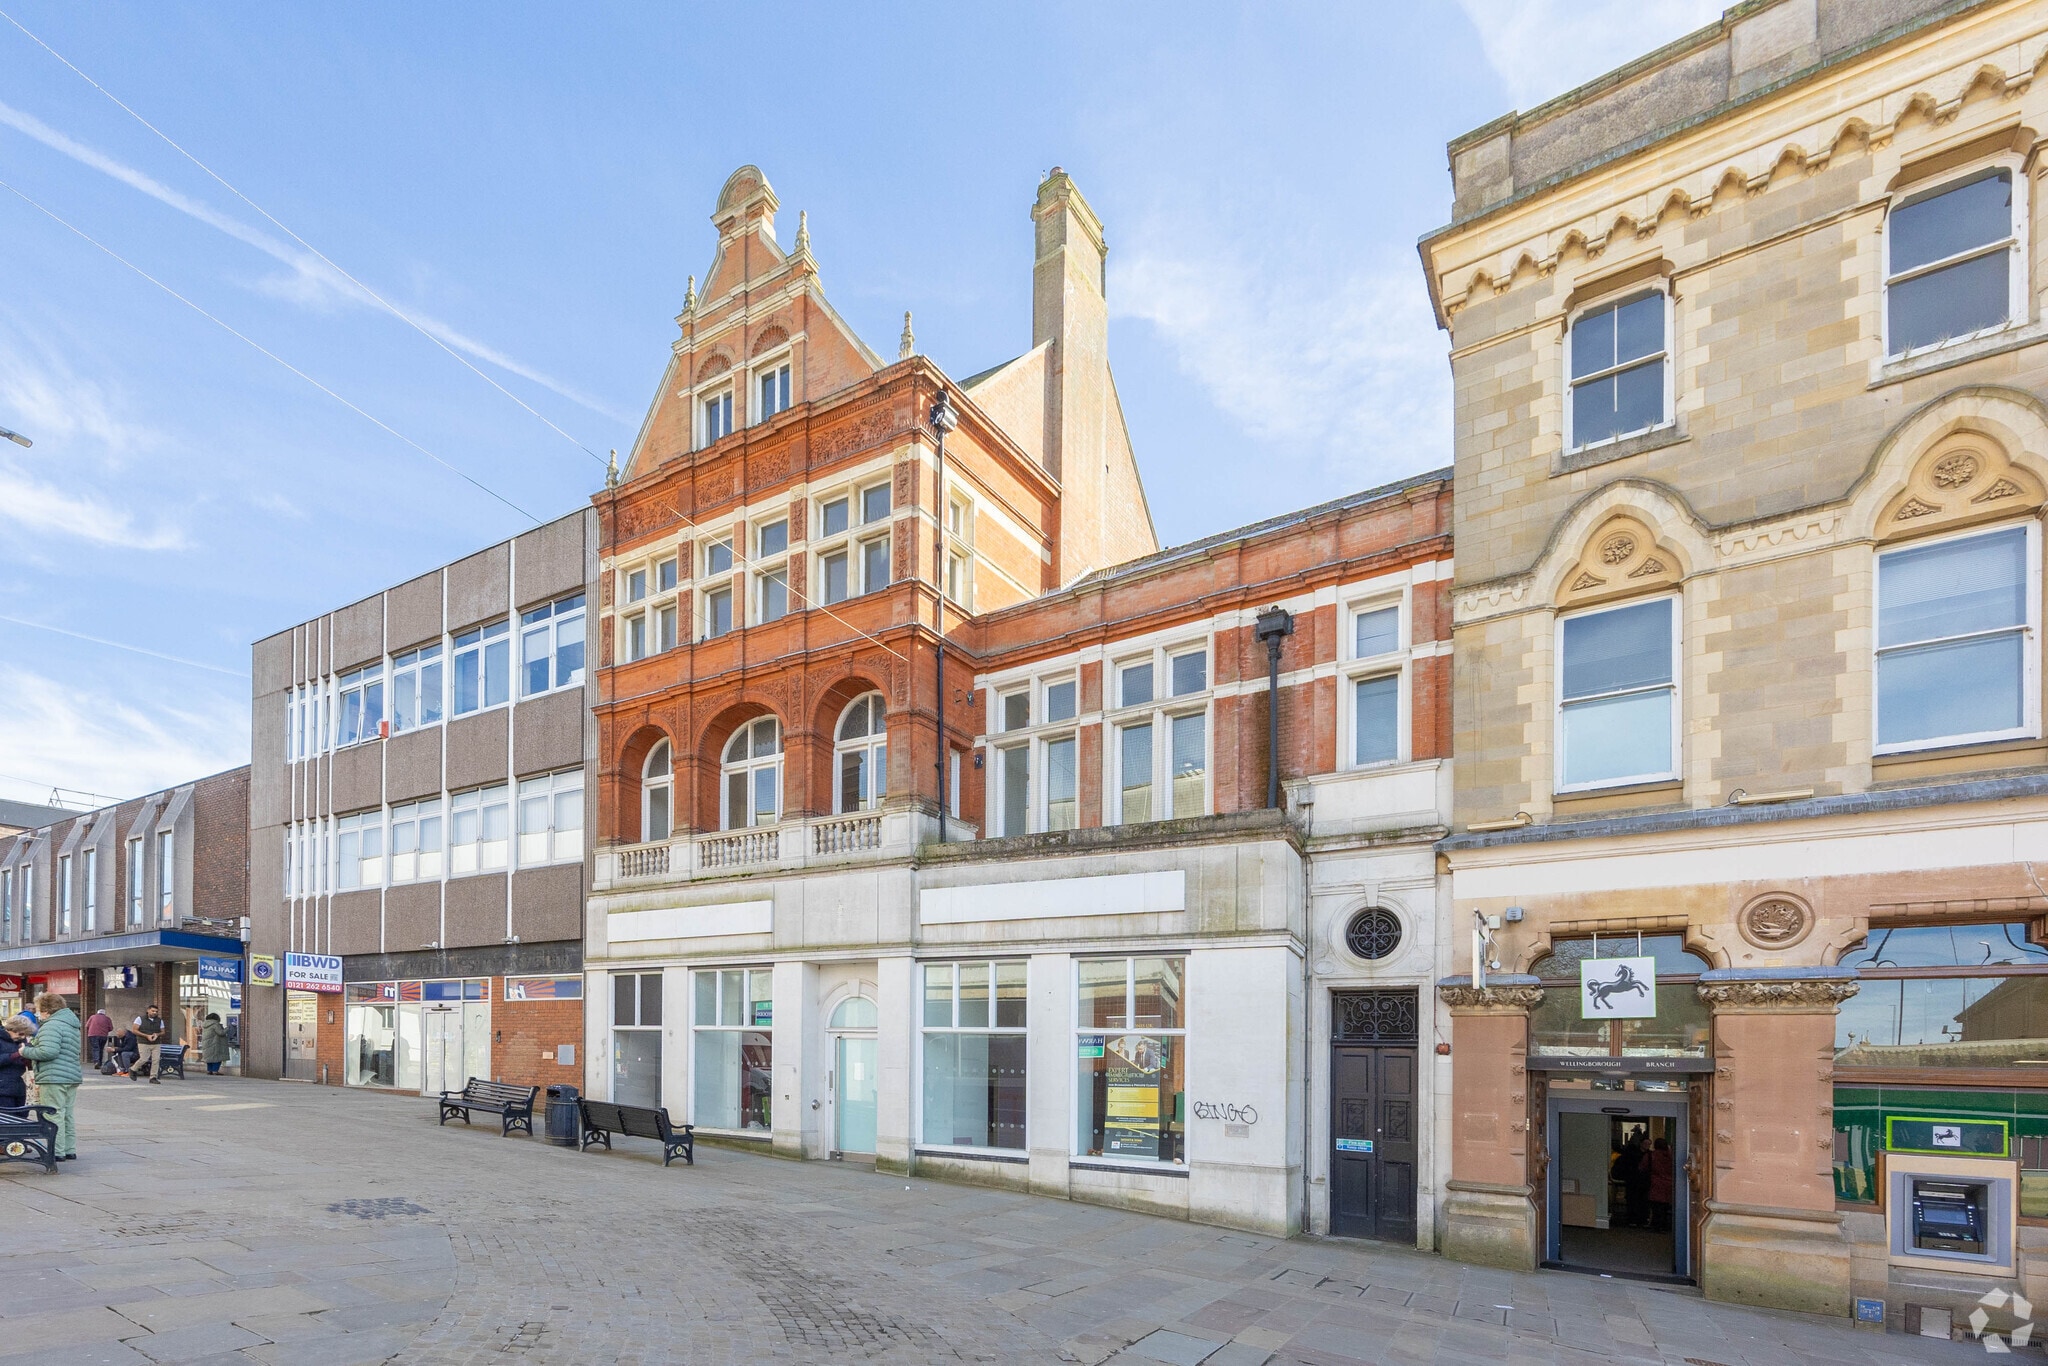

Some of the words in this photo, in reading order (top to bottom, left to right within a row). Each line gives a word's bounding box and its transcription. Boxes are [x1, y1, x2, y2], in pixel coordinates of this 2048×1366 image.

[200, 964, 237, 975] HALIFAX
[289, 971, 306, 979] FOR
[287, 981, 304, 989] 0121
[1193, 1101, 1258, 1125] BINGO
